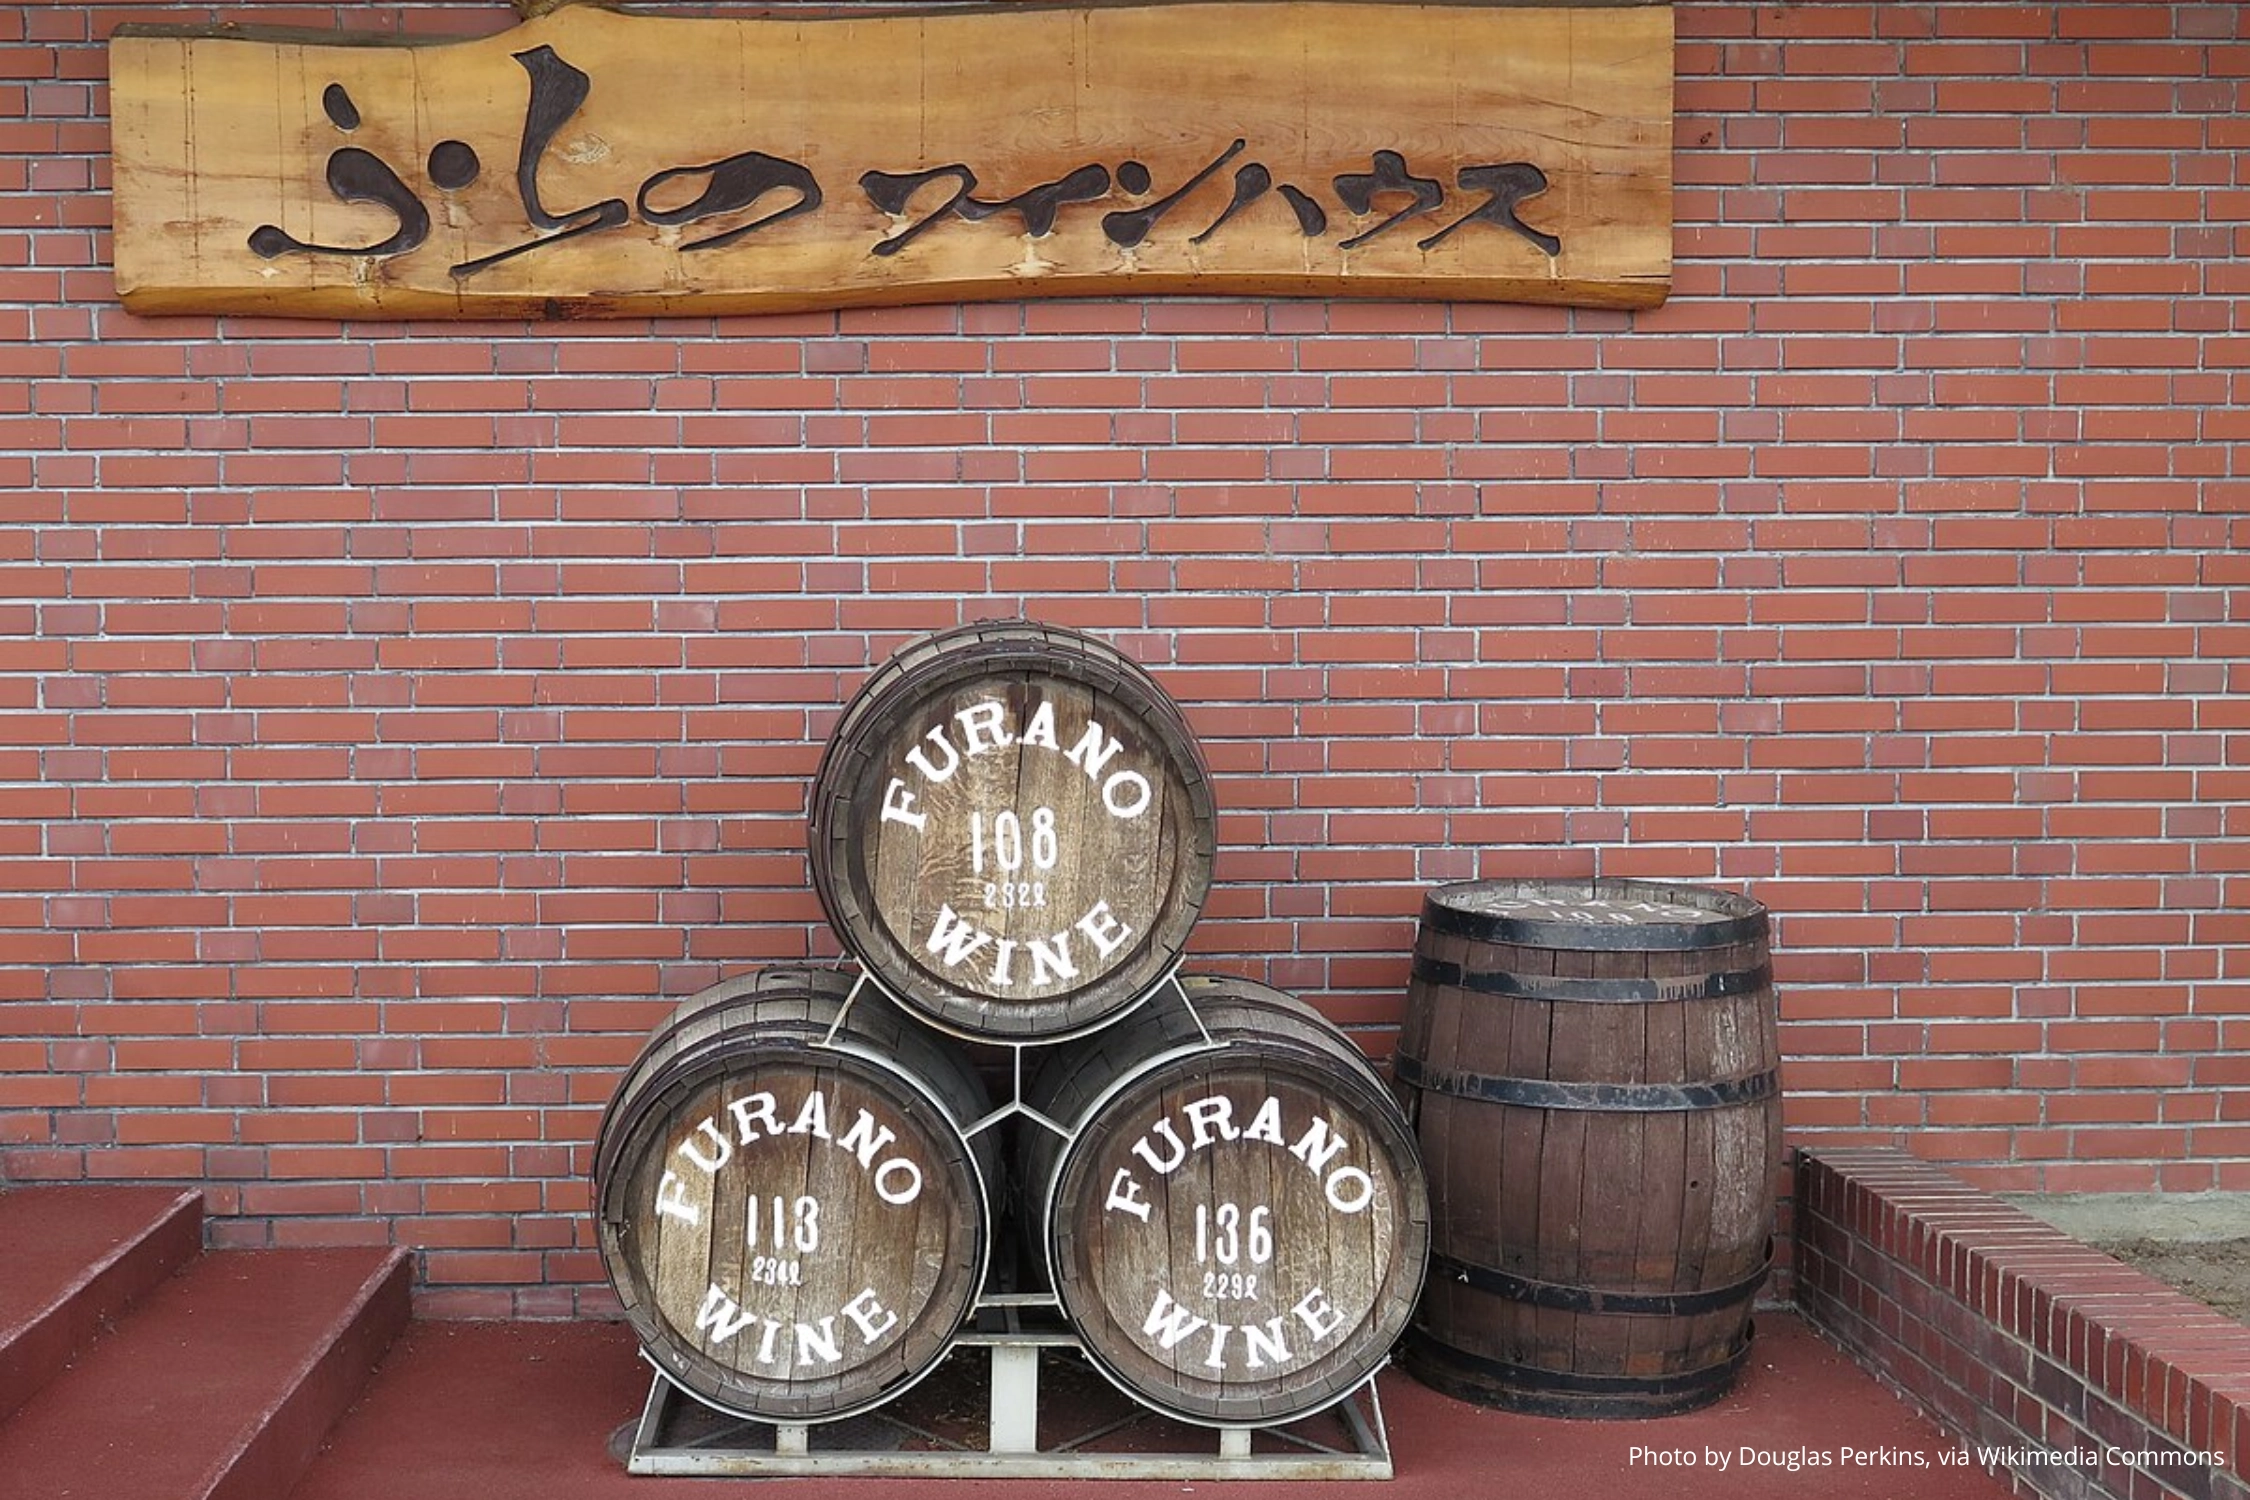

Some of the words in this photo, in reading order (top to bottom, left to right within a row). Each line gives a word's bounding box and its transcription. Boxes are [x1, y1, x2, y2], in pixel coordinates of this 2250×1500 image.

[881, 701, 1152, 834] FURANO
[971, 807, 1058, 873] 108
[926, 898, 1132, 986] WINE
[655, 1090, 923, 1227] FURANO
[1105, 1095, 1374, 1224] FURANO
[747, 1194, 819, 1253] 113
[1195, 1202, 1273, 1265] 136
[695, 1282, 898, 1366] WINE
[1142, 1287, 1345, 1369] WINE
